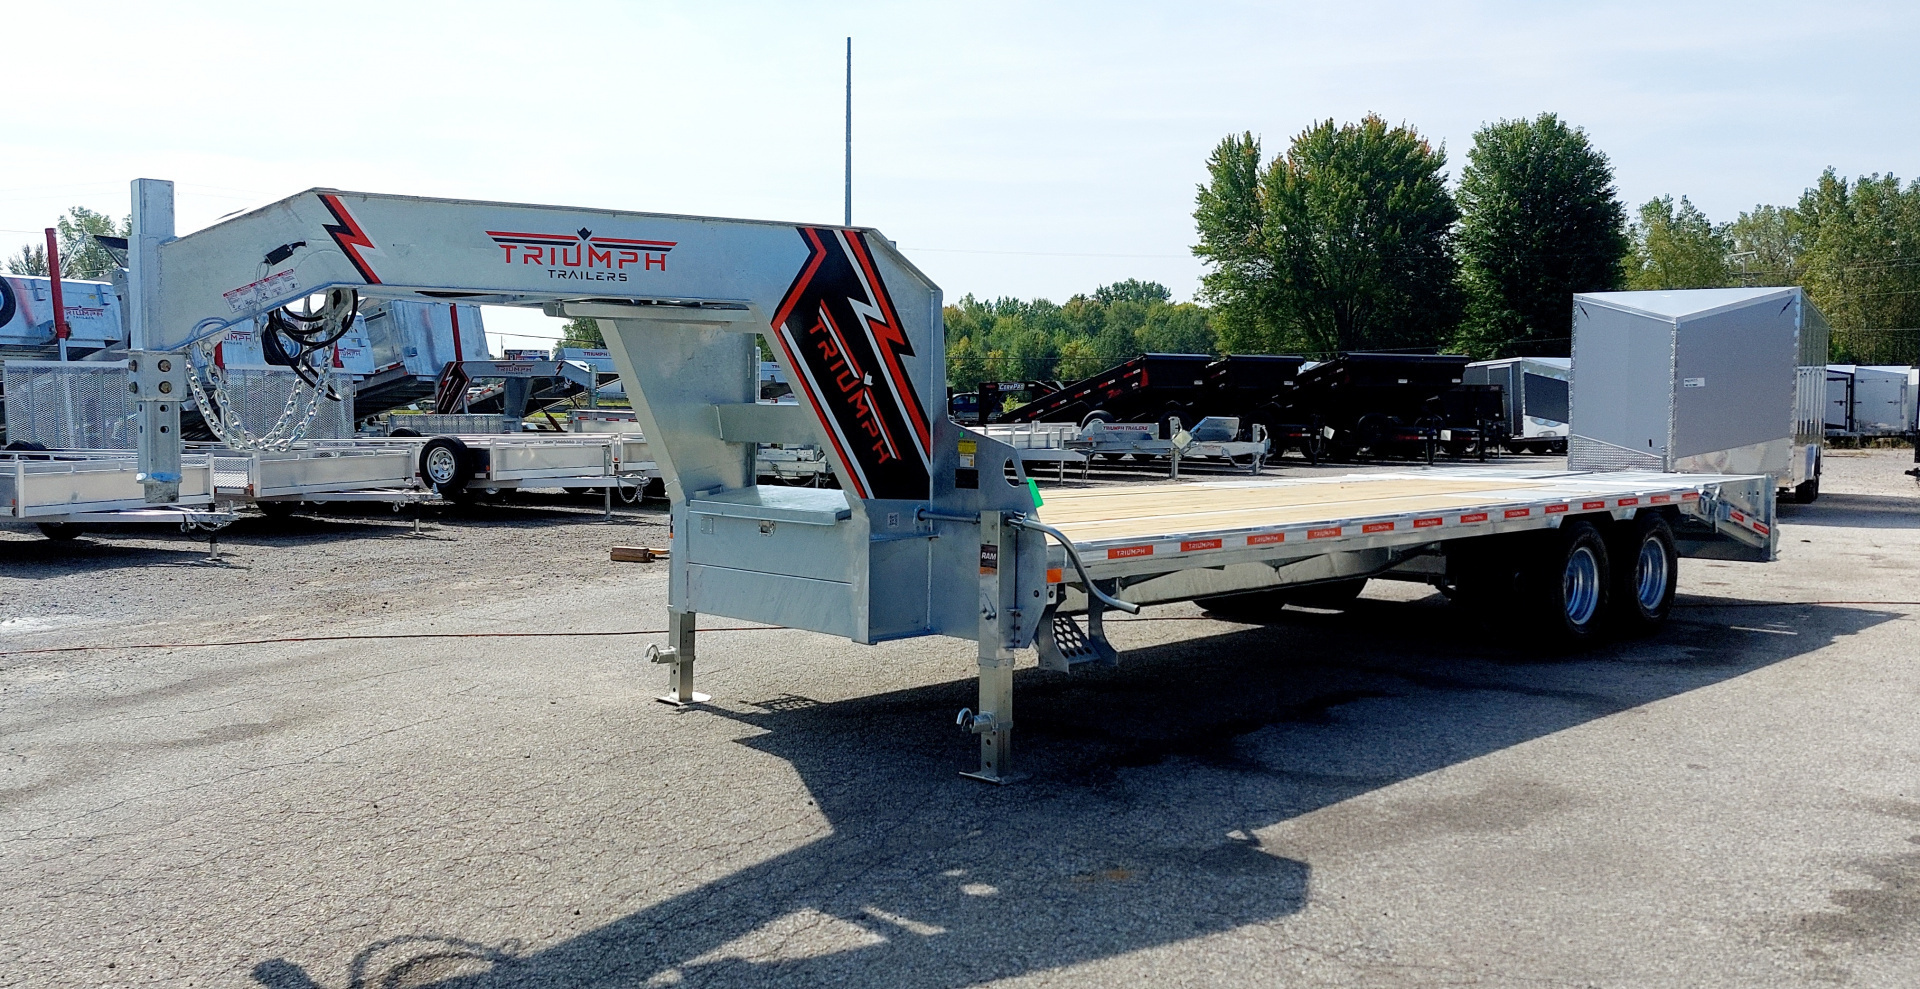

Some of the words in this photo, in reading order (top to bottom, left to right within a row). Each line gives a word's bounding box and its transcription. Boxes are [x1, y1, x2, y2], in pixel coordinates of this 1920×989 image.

[498, 242, 667, 271] TRIUMPH
[547, 269, 628, 282] TRAILERS
[65, 309, 104, 317] RIUMPH
[808, 315, 891, 464] TRIUMPH
[1313, 529, 1337, 537] TRIUMPH
[1253, 535, 1279, 543] TRIUMPH
[1188, 541, 1215, 550] TRIUMPH
[981, 551, 997, 560] RAM
[1116, 548, 1146, 557] TRIUMPH
